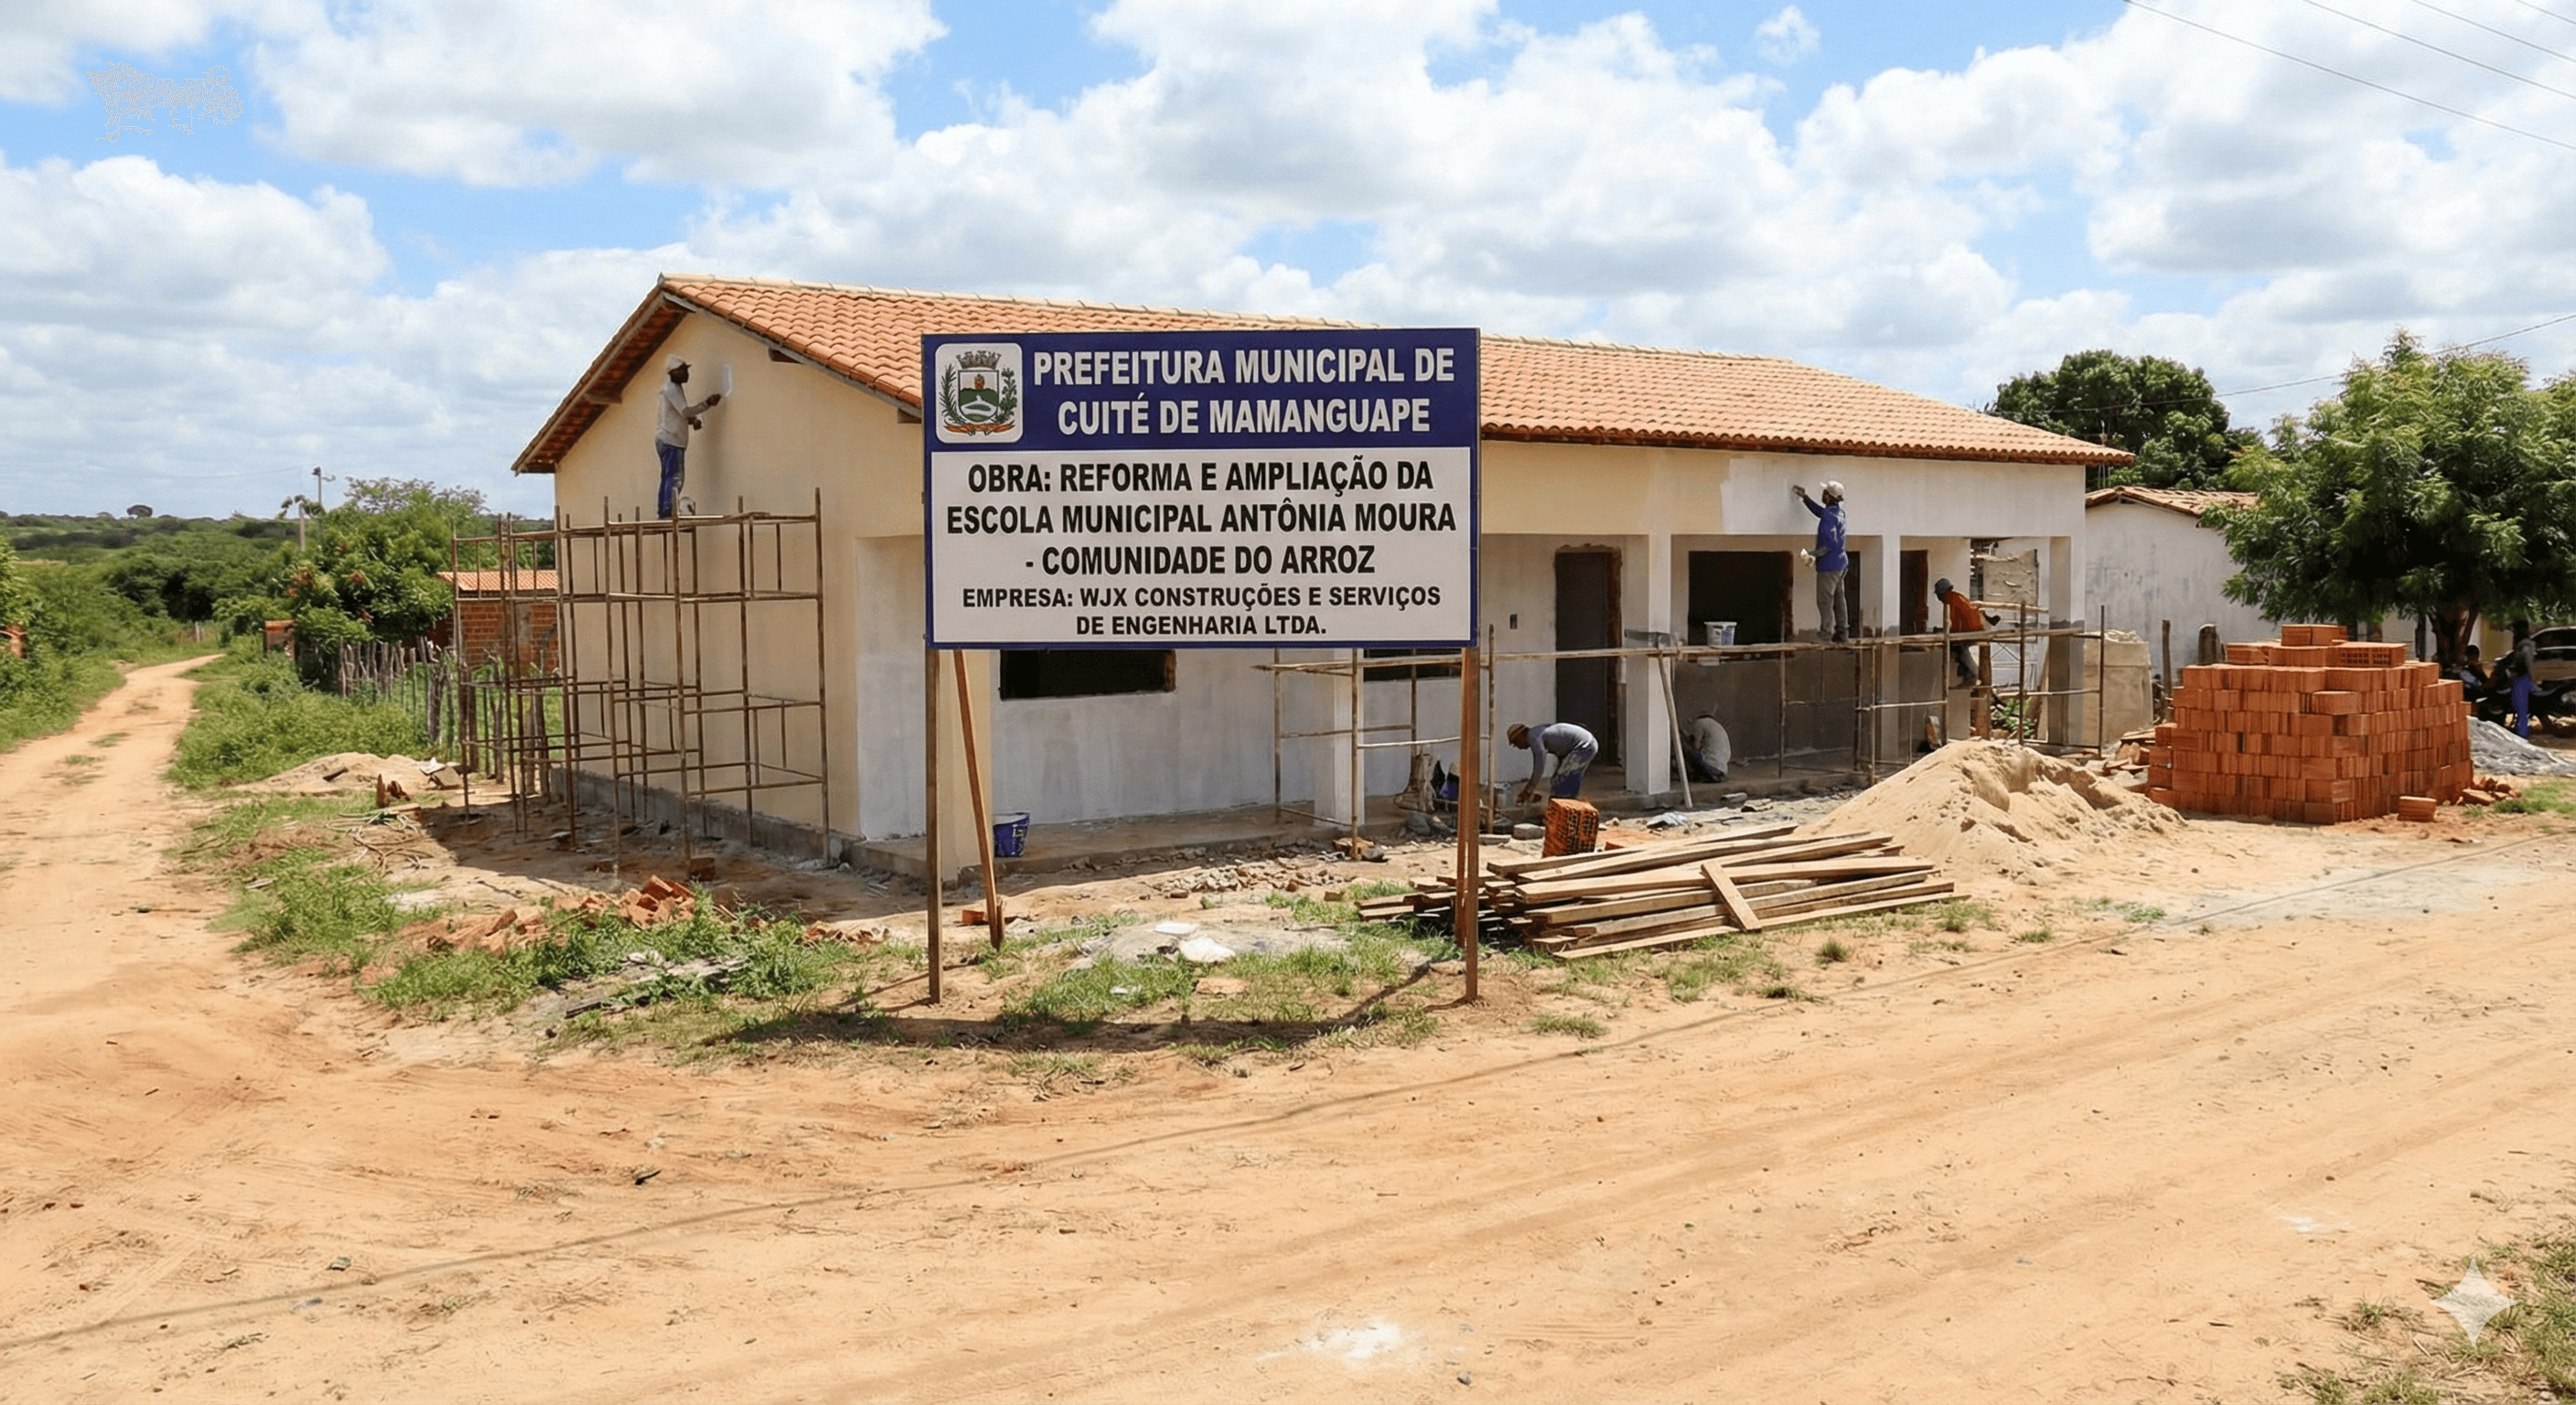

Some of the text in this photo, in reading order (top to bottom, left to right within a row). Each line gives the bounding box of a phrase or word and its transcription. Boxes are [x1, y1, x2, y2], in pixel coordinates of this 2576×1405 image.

[1035, 349, 1454, 385] PREFEITURA MUNICIPAL DE
[1058, 392, 1429, 434] CUITÉ DE MAMANGUAPE
[969, 456, 1433, 496] OBRA: REFORMA E AMPLIAÇÃO DA
[948, 498, 1456, 534] ESCOLA MUNICIPAL ANTÔNIA MOURA
[1043, 546, 1225, 574] COMUNIDADE
[1235, 546, 1272, 574] DO
[1281, 545, 1375, 574] ARROZ
[963, 584, 1440, 611] EMPRESA: WJX CONSTRUÇÕES E SERVIÇOS
[1077, 616, 1326, 635] DE ENGENHARIA LTDA.
